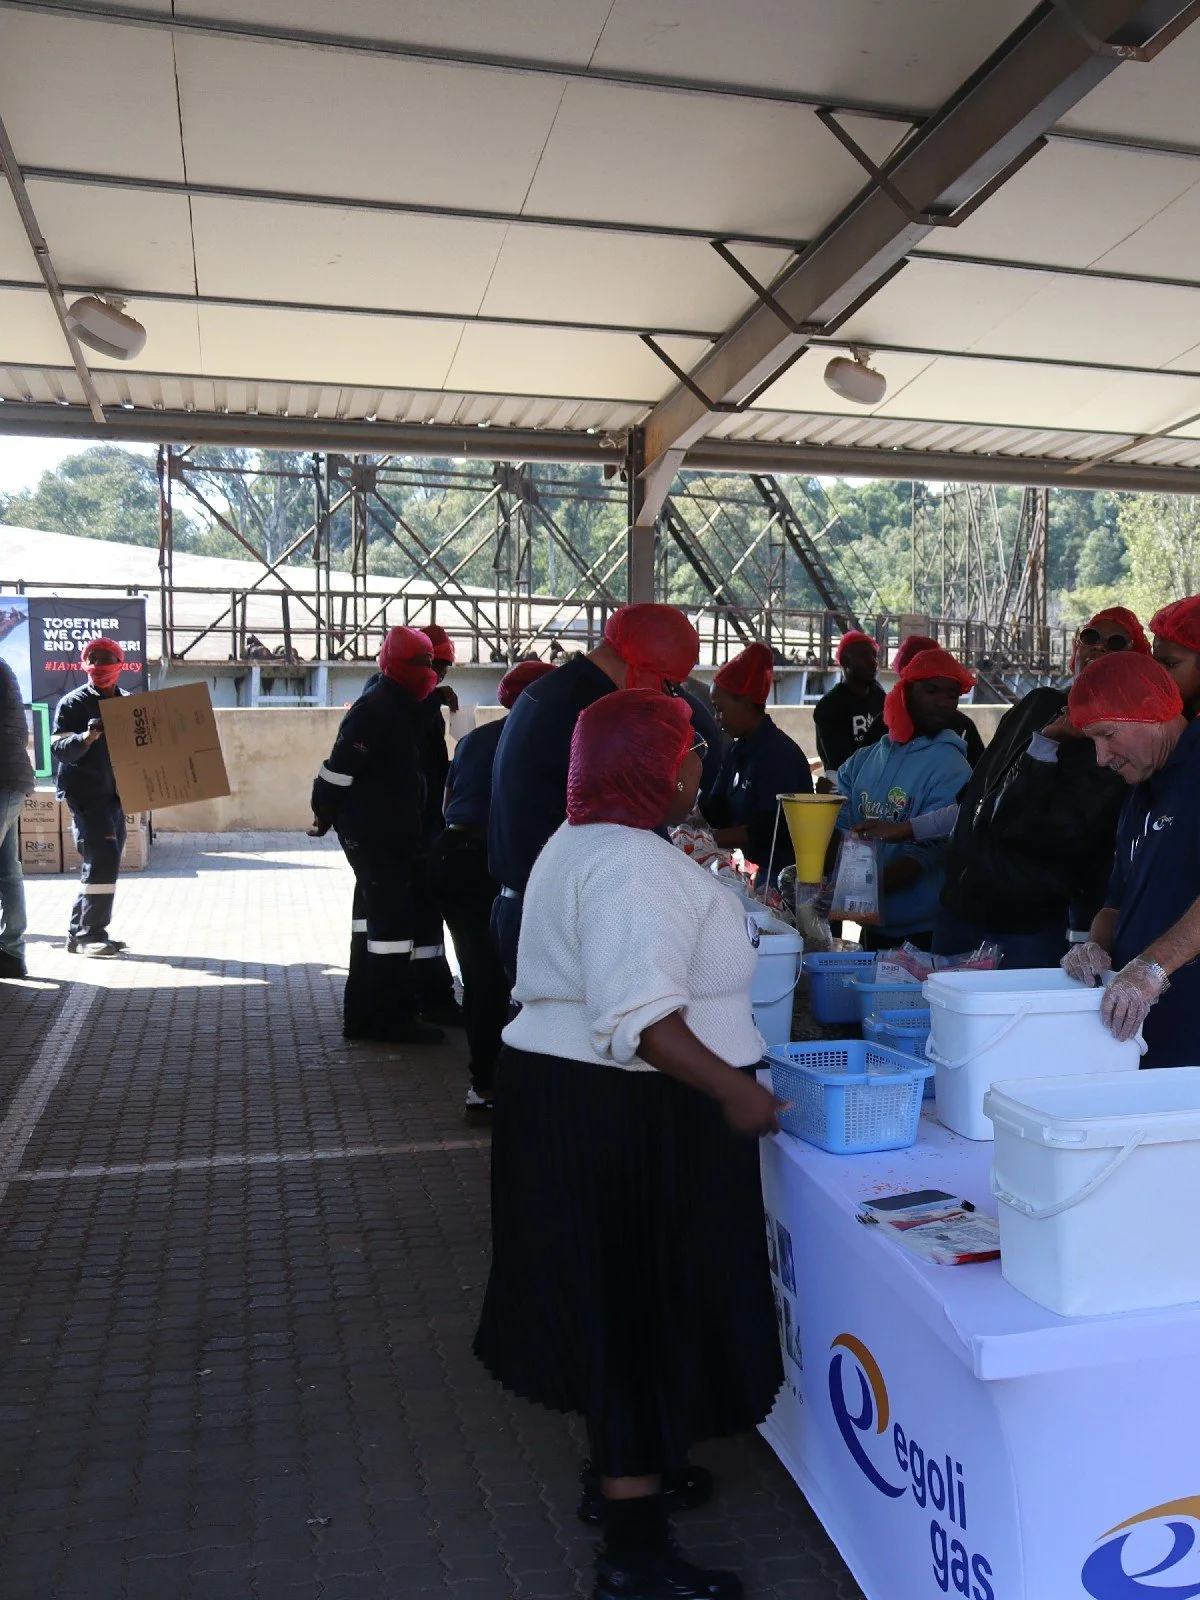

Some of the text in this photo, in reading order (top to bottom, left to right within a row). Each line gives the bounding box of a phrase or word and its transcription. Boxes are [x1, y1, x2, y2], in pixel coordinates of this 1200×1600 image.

[43, 617, 119, 629] TOGETHER
[43, 629, 103, 640] WE CAN
[44, 640, 141, 651] END HER!
[24, 799, 55, 809] Rise
[894, 1422, 967, 1531] egoli
[930, 1519, 995, 1600] gas
